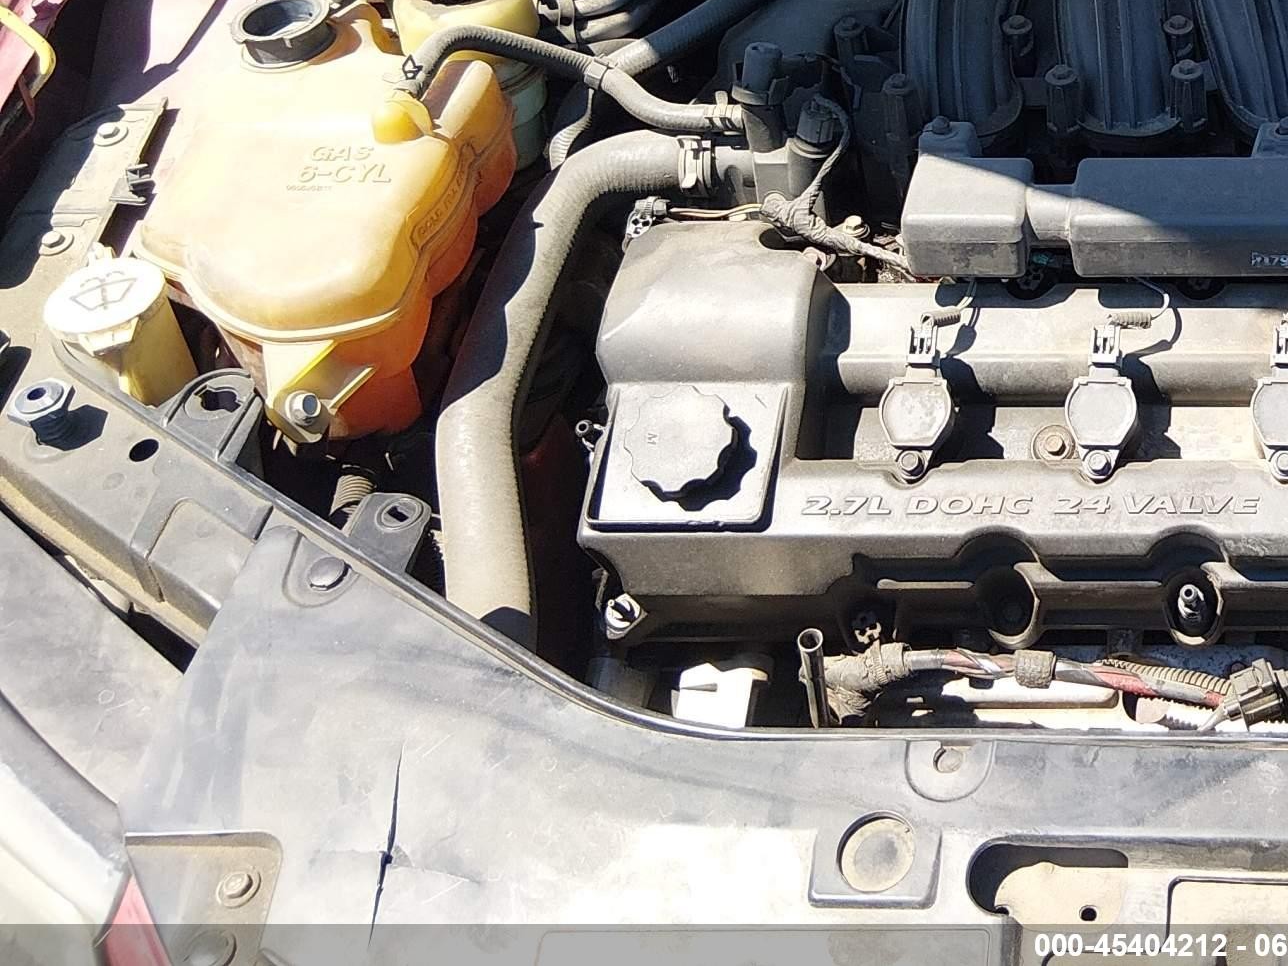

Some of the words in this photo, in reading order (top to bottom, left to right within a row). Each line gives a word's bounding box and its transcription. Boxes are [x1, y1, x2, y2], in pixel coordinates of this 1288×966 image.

[311, 146, 375, 162] GAS
[299, 164, 392, 184] 6-CYL
[801, 496, 892, 516] 2.7L
[905, 496, 1034, 516] DOHC
[1053, 496, 1112, 516] 24
[1123, 496, 1261, 516] VALVE
